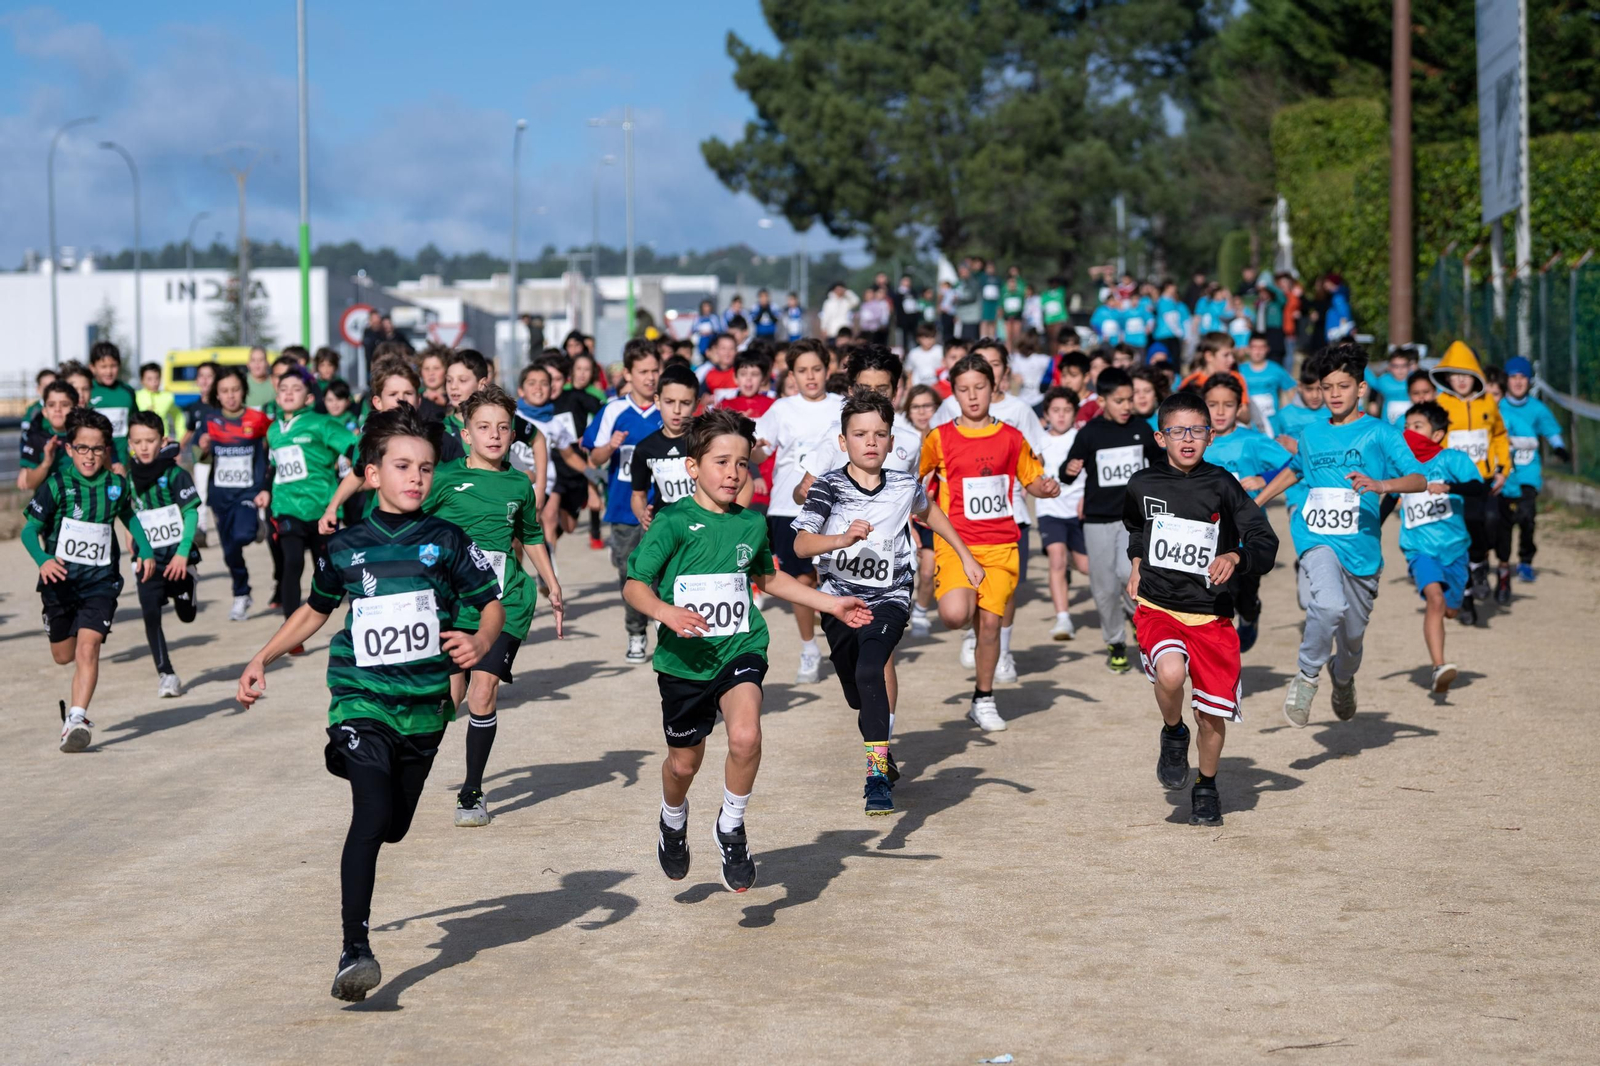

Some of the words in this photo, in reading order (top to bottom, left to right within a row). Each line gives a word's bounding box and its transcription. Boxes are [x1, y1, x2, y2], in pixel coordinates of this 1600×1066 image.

[277, 460, 303, 478] 208
[665, 479, 696, 497] 0118
[1306, 509, 1353, 529] 0339
[1406, 498, 1447, 522] 0325
[65, 539, 106, 560] 0231
[1155, 539, 1211, 568] 0485
[836, 550, 889, 581] 0488
[364, 622, 429, 657] 0219
